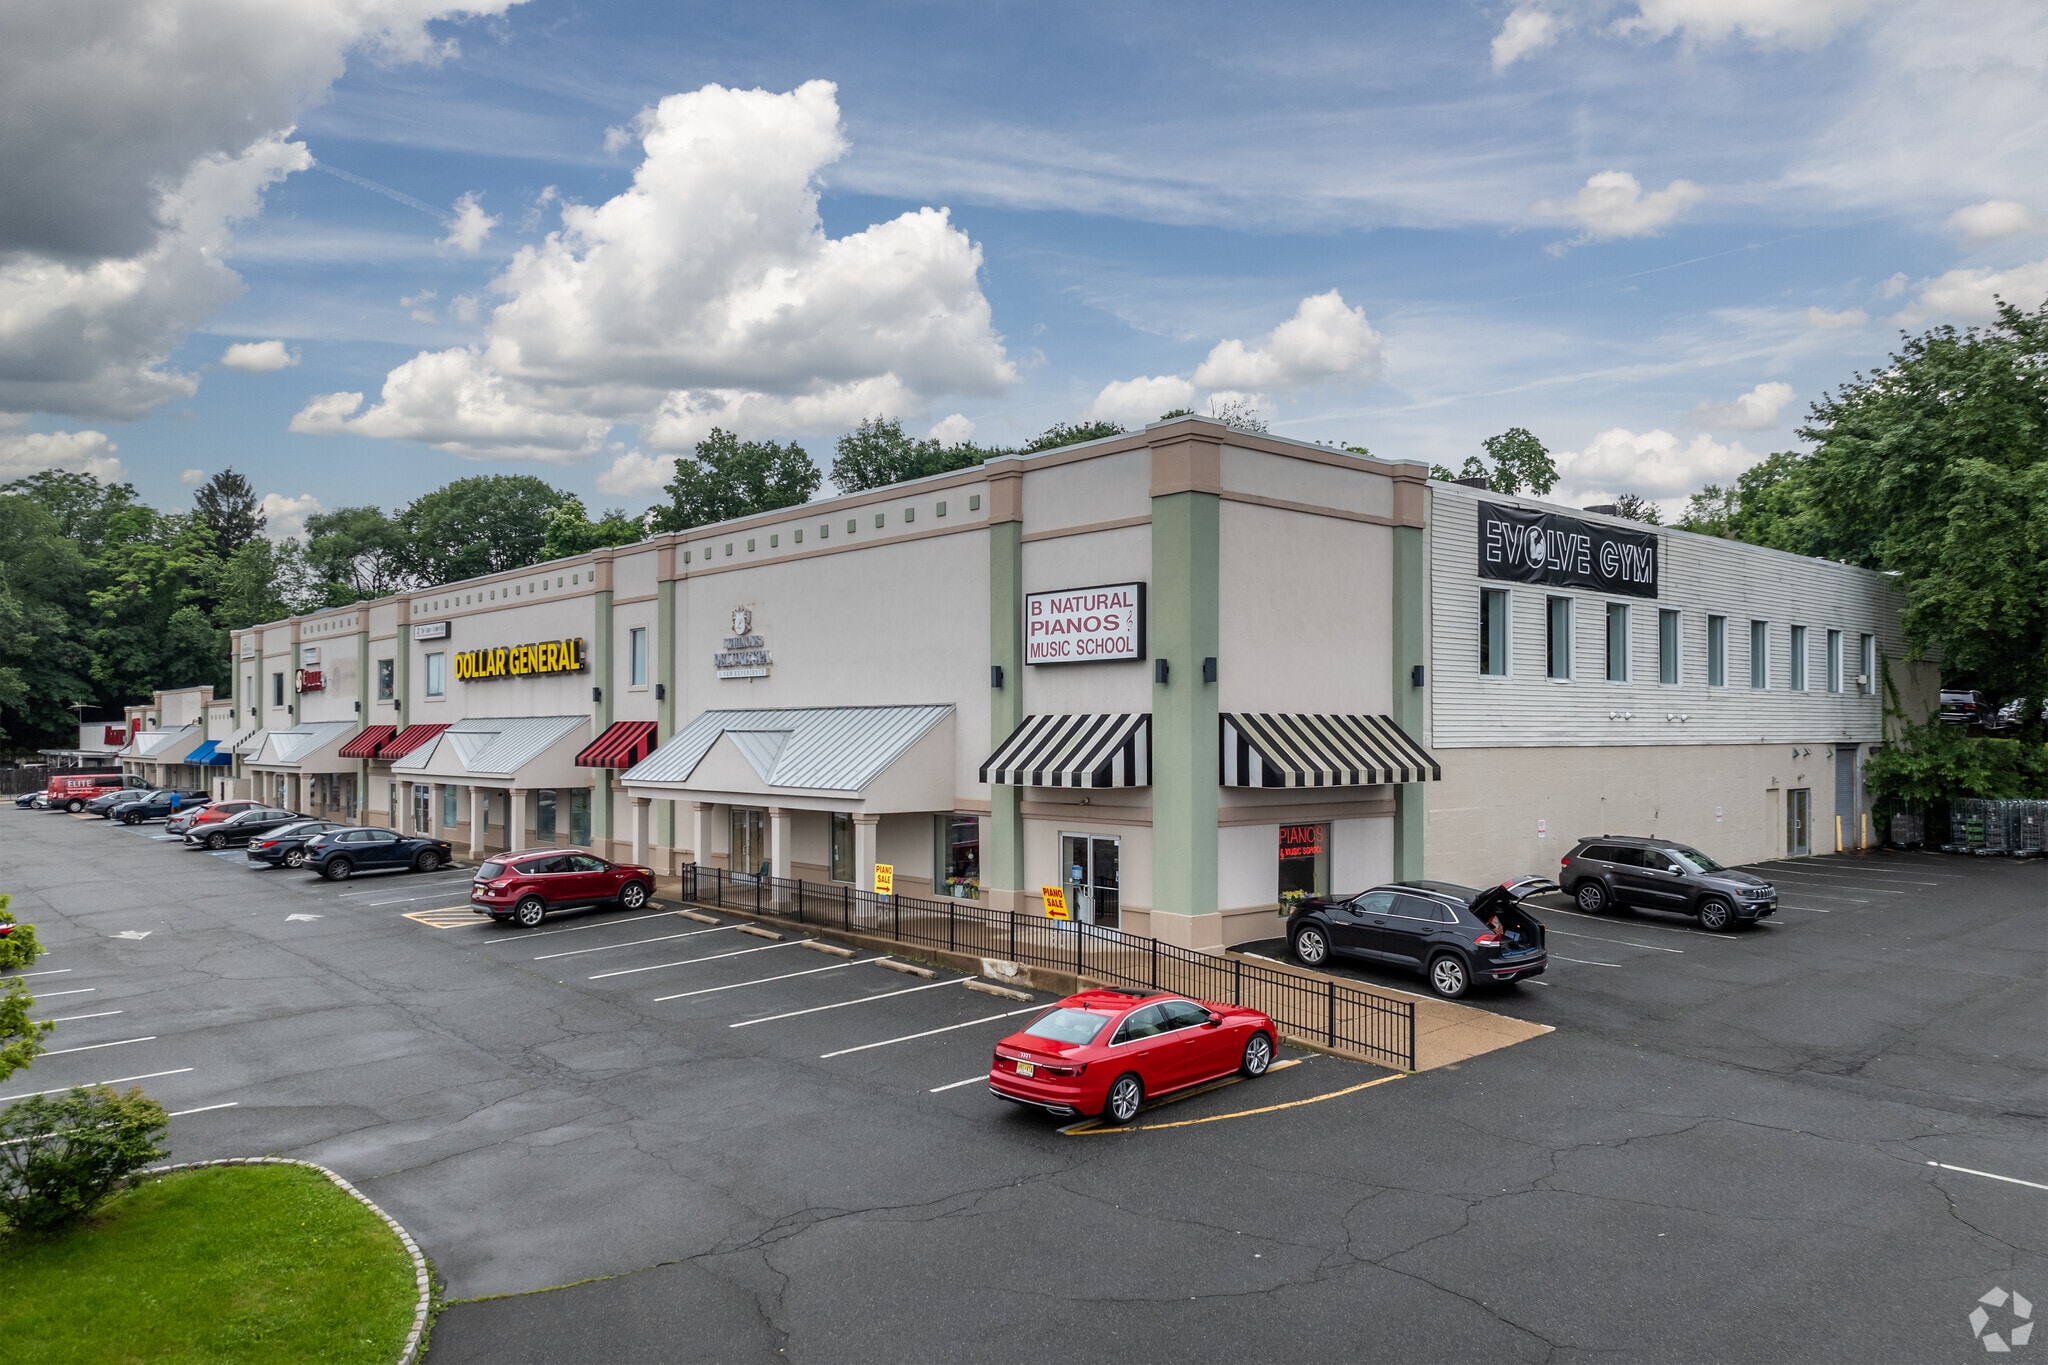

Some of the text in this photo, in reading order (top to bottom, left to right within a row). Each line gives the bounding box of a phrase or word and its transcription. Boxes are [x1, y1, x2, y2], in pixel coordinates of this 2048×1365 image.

[1486, 519, 1652, 584] EVOLVE GYM
[1031, 591, 1134, 617] B NATURAL
[1030, 613, 1120, 637] PIANOS
[1030, 636, 1134, 658] MUSIC SCHOOL
[454, 640, 580, 679] DOLLAR GENERAL
[67, 779, 92, 788] ELITE
[1279, 825, 1324, 845] PIANOS
[1285, 847, 1301, 856] MUSIC
[876, 865, 892, 875] PIANO
[877, 874, 891, 884] SALE
[1042, 887, 1063, 898] PIANO
[1047, 898, 1063, 909] SALE
